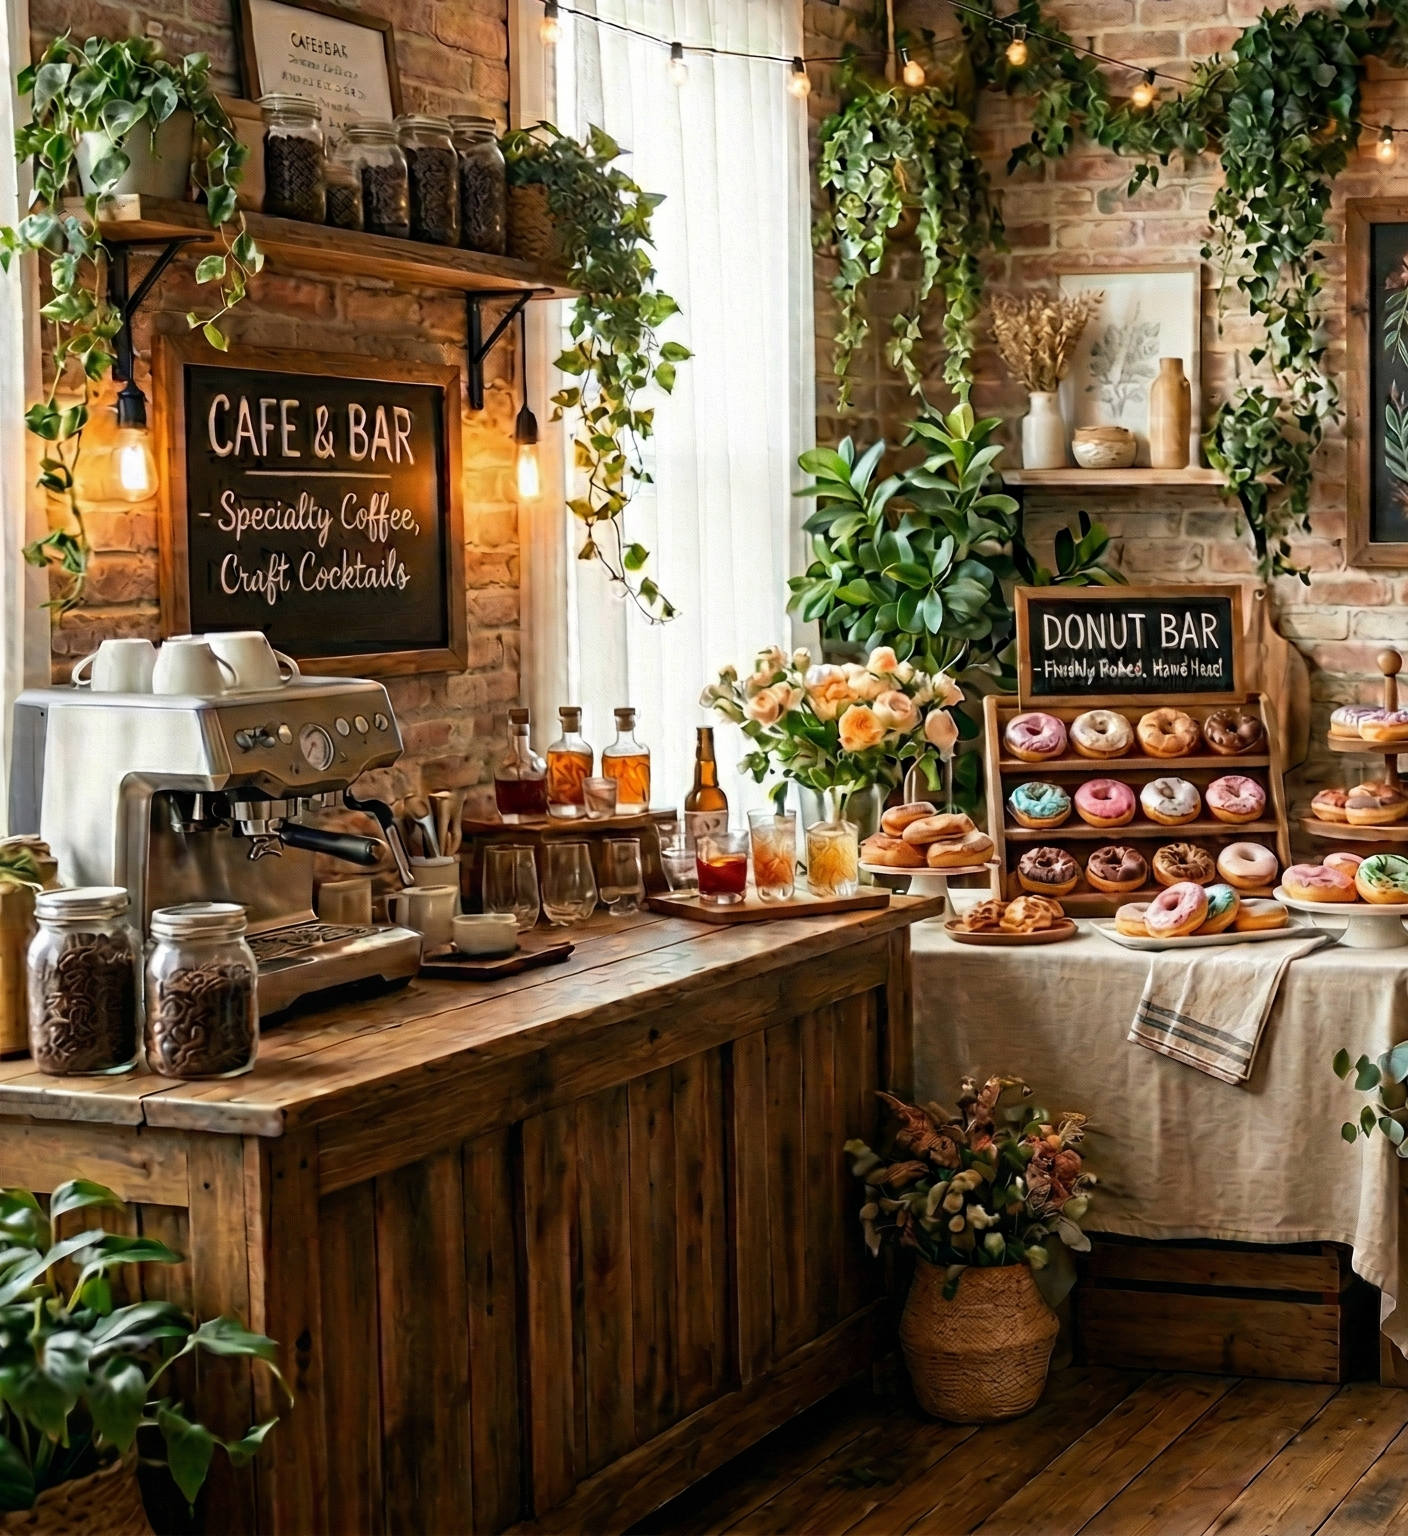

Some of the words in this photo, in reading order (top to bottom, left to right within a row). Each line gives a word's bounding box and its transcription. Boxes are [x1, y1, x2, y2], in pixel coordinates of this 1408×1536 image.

[208, 393, 301, 458] CAFE
[314, 404, 336, 460] &
[348, 403, 416, 466] BAR
[217, 490, 334, 548] Specialty
[340, 492, 420, 543] Coffee,
[220, 552, 291, 606] Craft
[298, 547, 411, 592] Cocktails
[1043, 612, 1146, 651] DONUT
[1160, 611, 1219, 650] BAR
